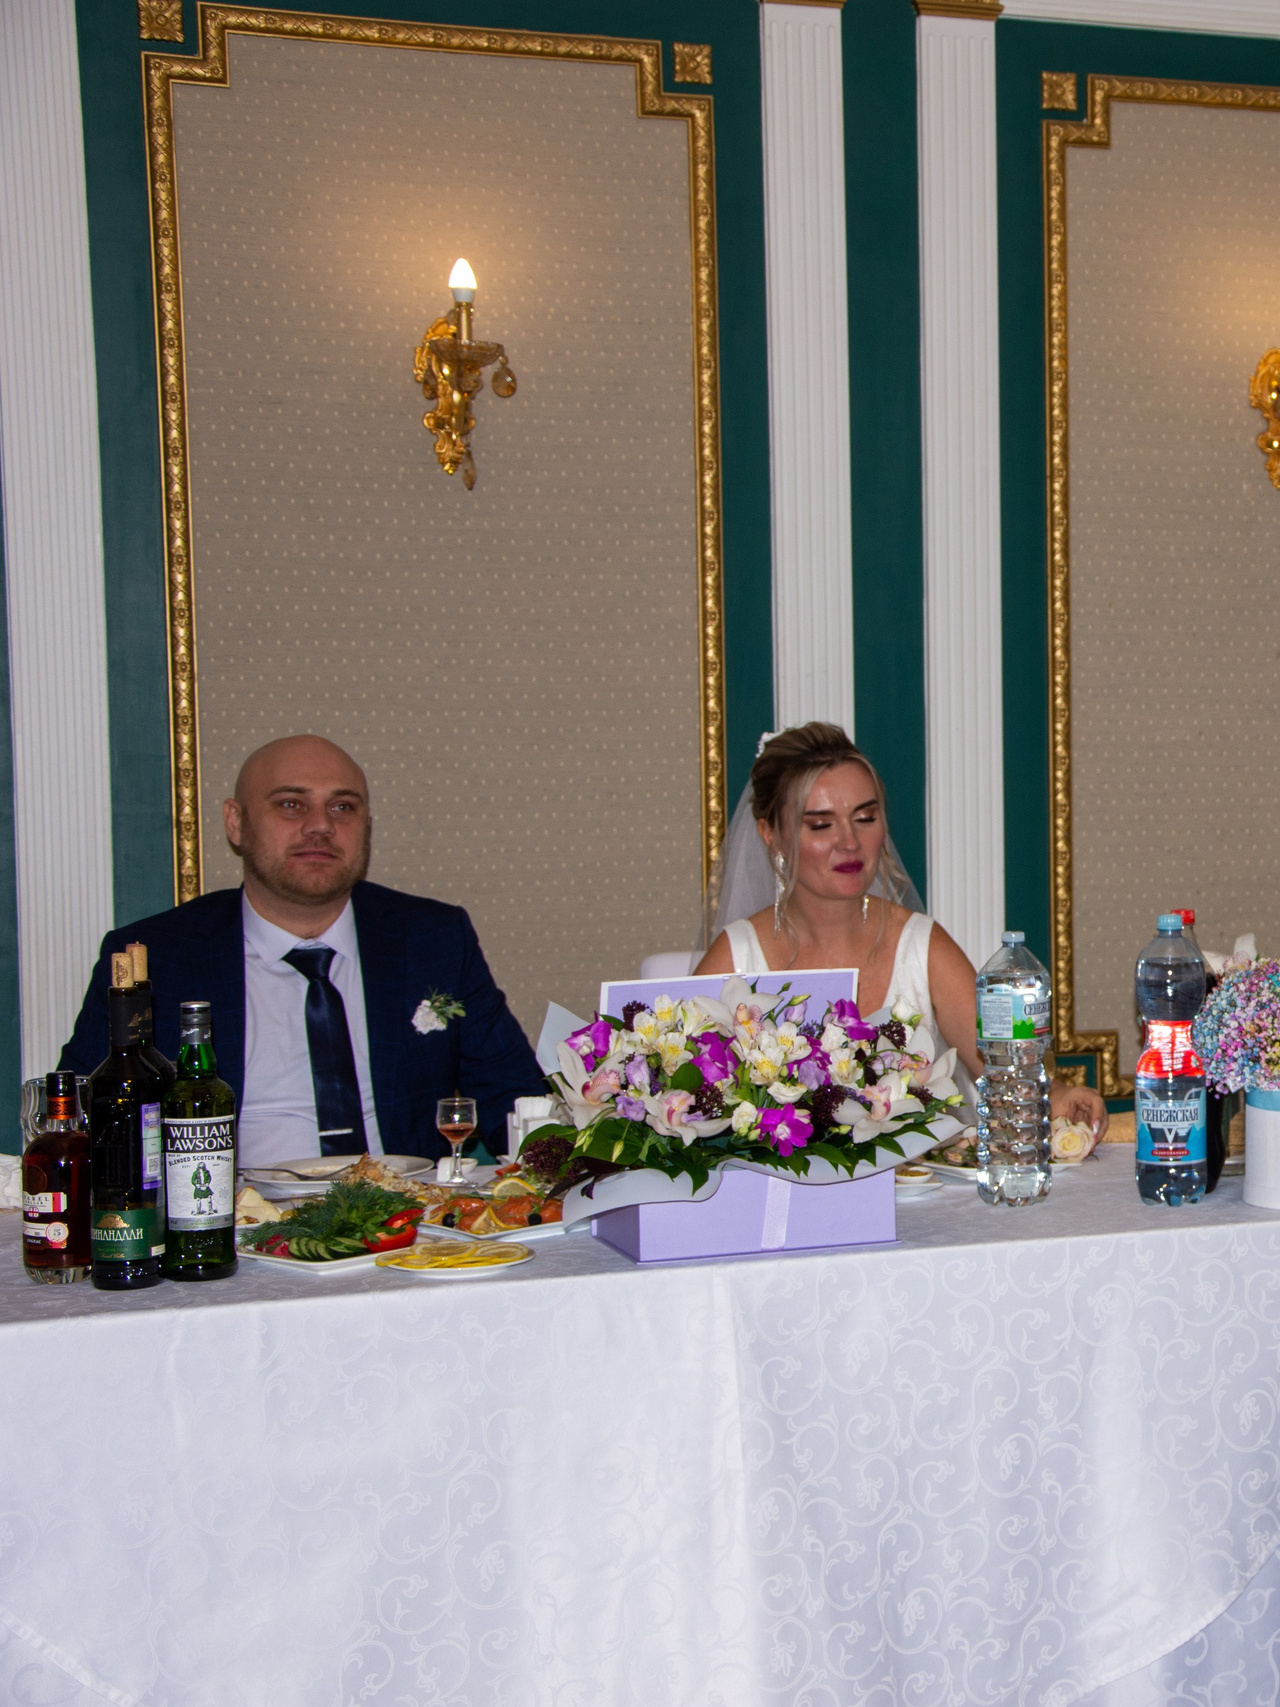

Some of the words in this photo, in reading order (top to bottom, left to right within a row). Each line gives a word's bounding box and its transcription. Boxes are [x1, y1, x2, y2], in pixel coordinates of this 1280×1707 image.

[1142, 1108, 1199, 1122] СЕНЕЖСКАЯ
[169, 1124, 230, 1138] WILLIAM
[167, 1136, 233, 1151] LAWSON'S
[168, 1157, 191, 1166] BLENDED
